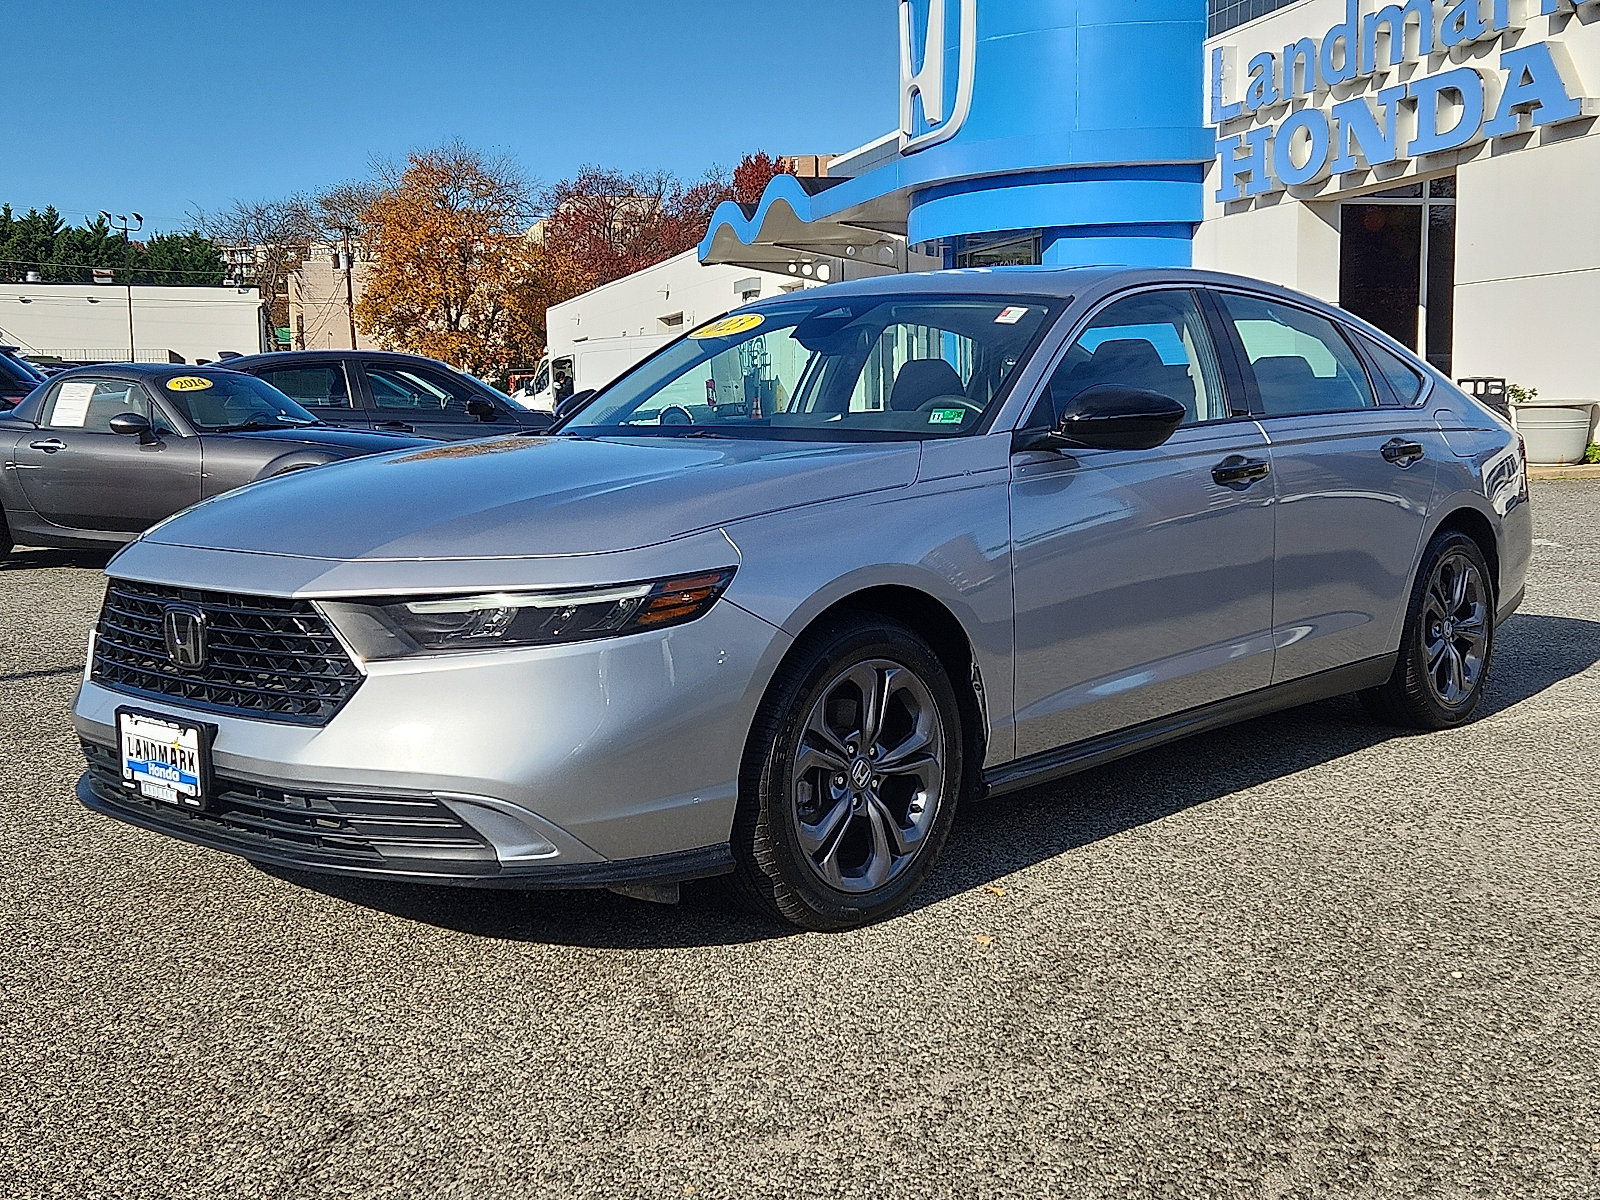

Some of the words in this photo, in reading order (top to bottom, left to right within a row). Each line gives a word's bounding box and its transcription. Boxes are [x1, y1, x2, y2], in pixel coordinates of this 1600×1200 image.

[1211, 0, 1600, 124] Landma
[1215, 41, 1582, 203] HONDA
[175, 378, 206, 390] 2014
[127, 736, 196, 774] LANDMARK
[148, 762, 180, 782] Honda
